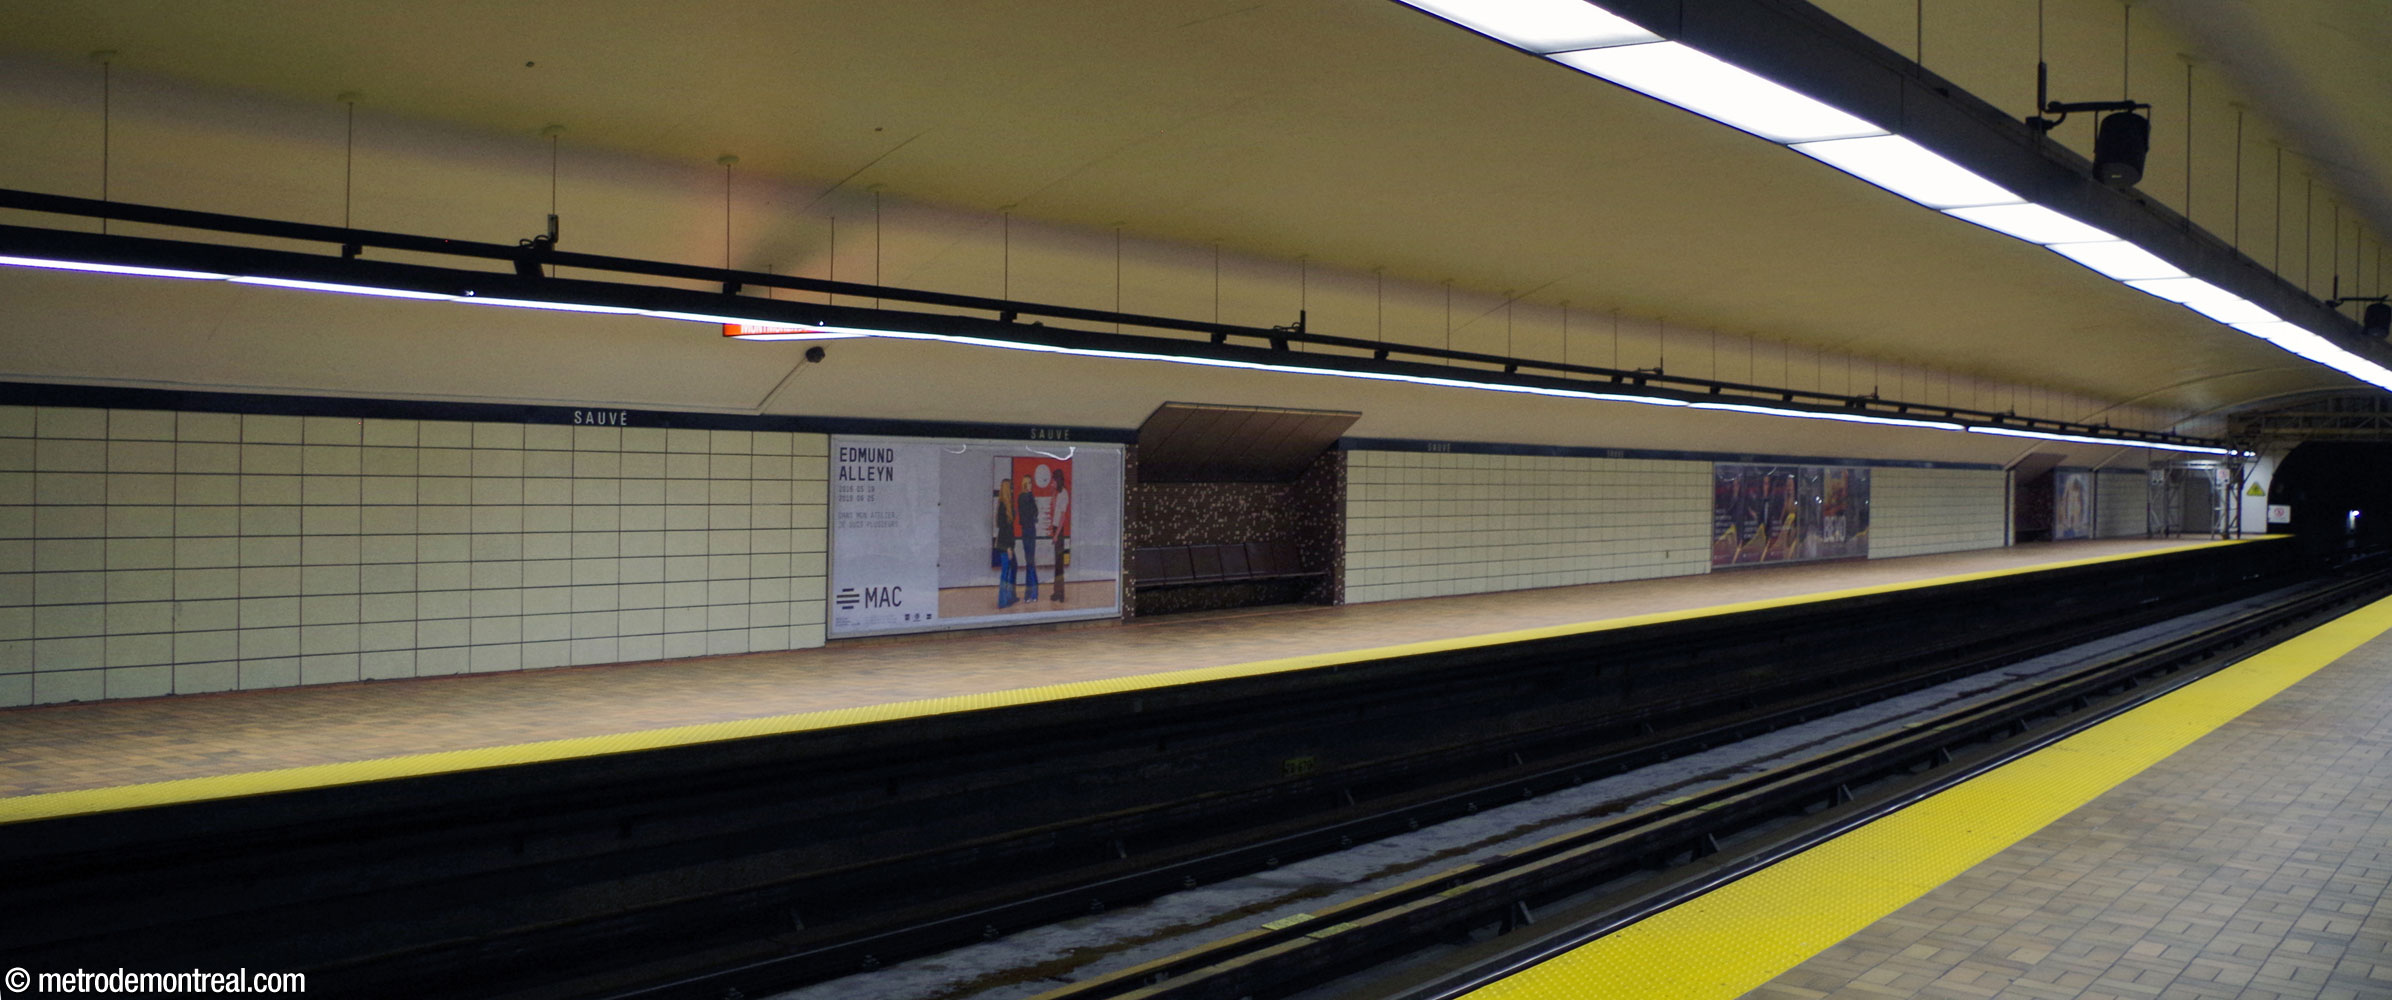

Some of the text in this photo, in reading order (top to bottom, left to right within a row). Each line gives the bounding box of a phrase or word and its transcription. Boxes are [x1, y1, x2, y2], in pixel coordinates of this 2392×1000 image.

[574, 410, 627, 425] SAUVÉ
[839, 447, 894, 463] EDMUND
[839, 466, 894, 482] ALLEYN
[865, 586, 902, 608] MAC
